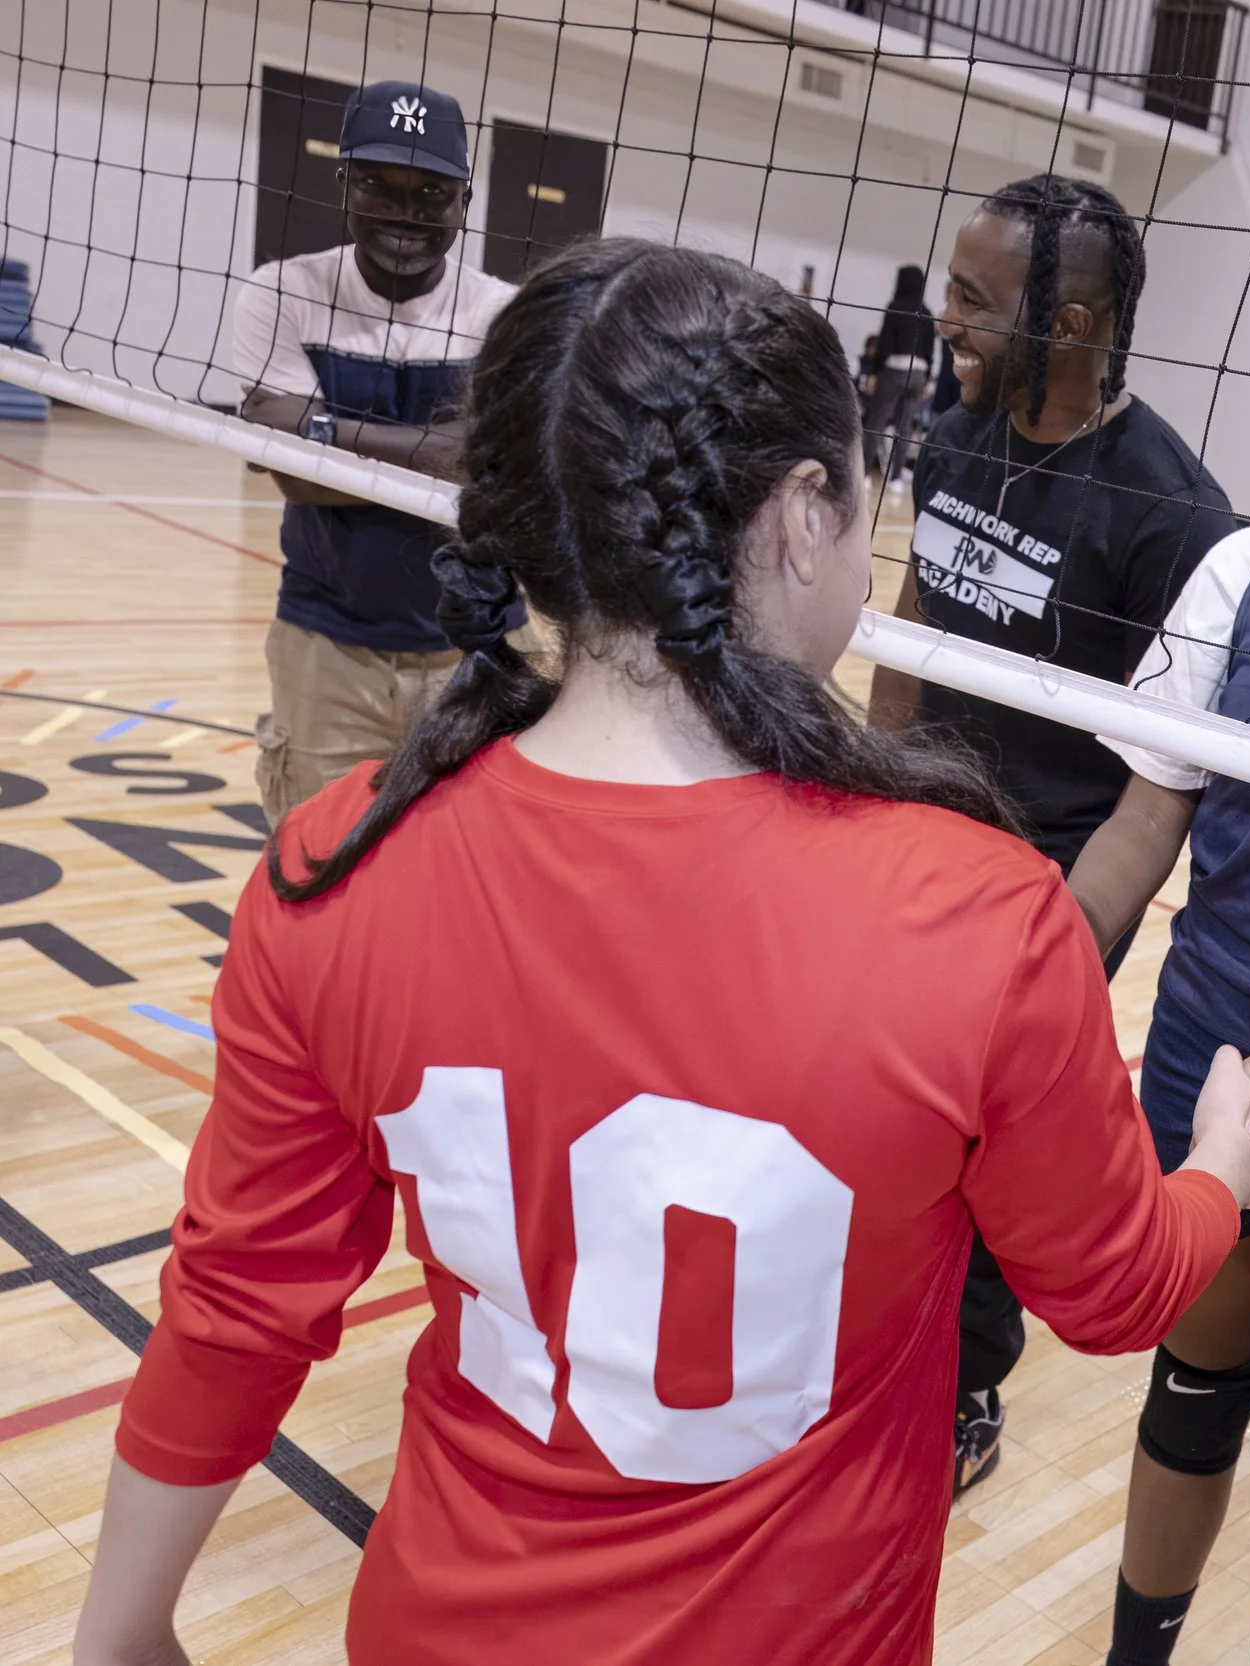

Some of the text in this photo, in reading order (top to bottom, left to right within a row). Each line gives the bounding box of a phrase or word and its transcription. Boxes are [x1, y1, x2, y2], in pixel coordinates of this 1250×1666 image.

[390, 95, 428, 135] NY
[928, 490, 1063, 567] RICHWORK REP
[918, 558, 1017, 627] ACADEMY
[374, 1066, 855, 1484] 10
